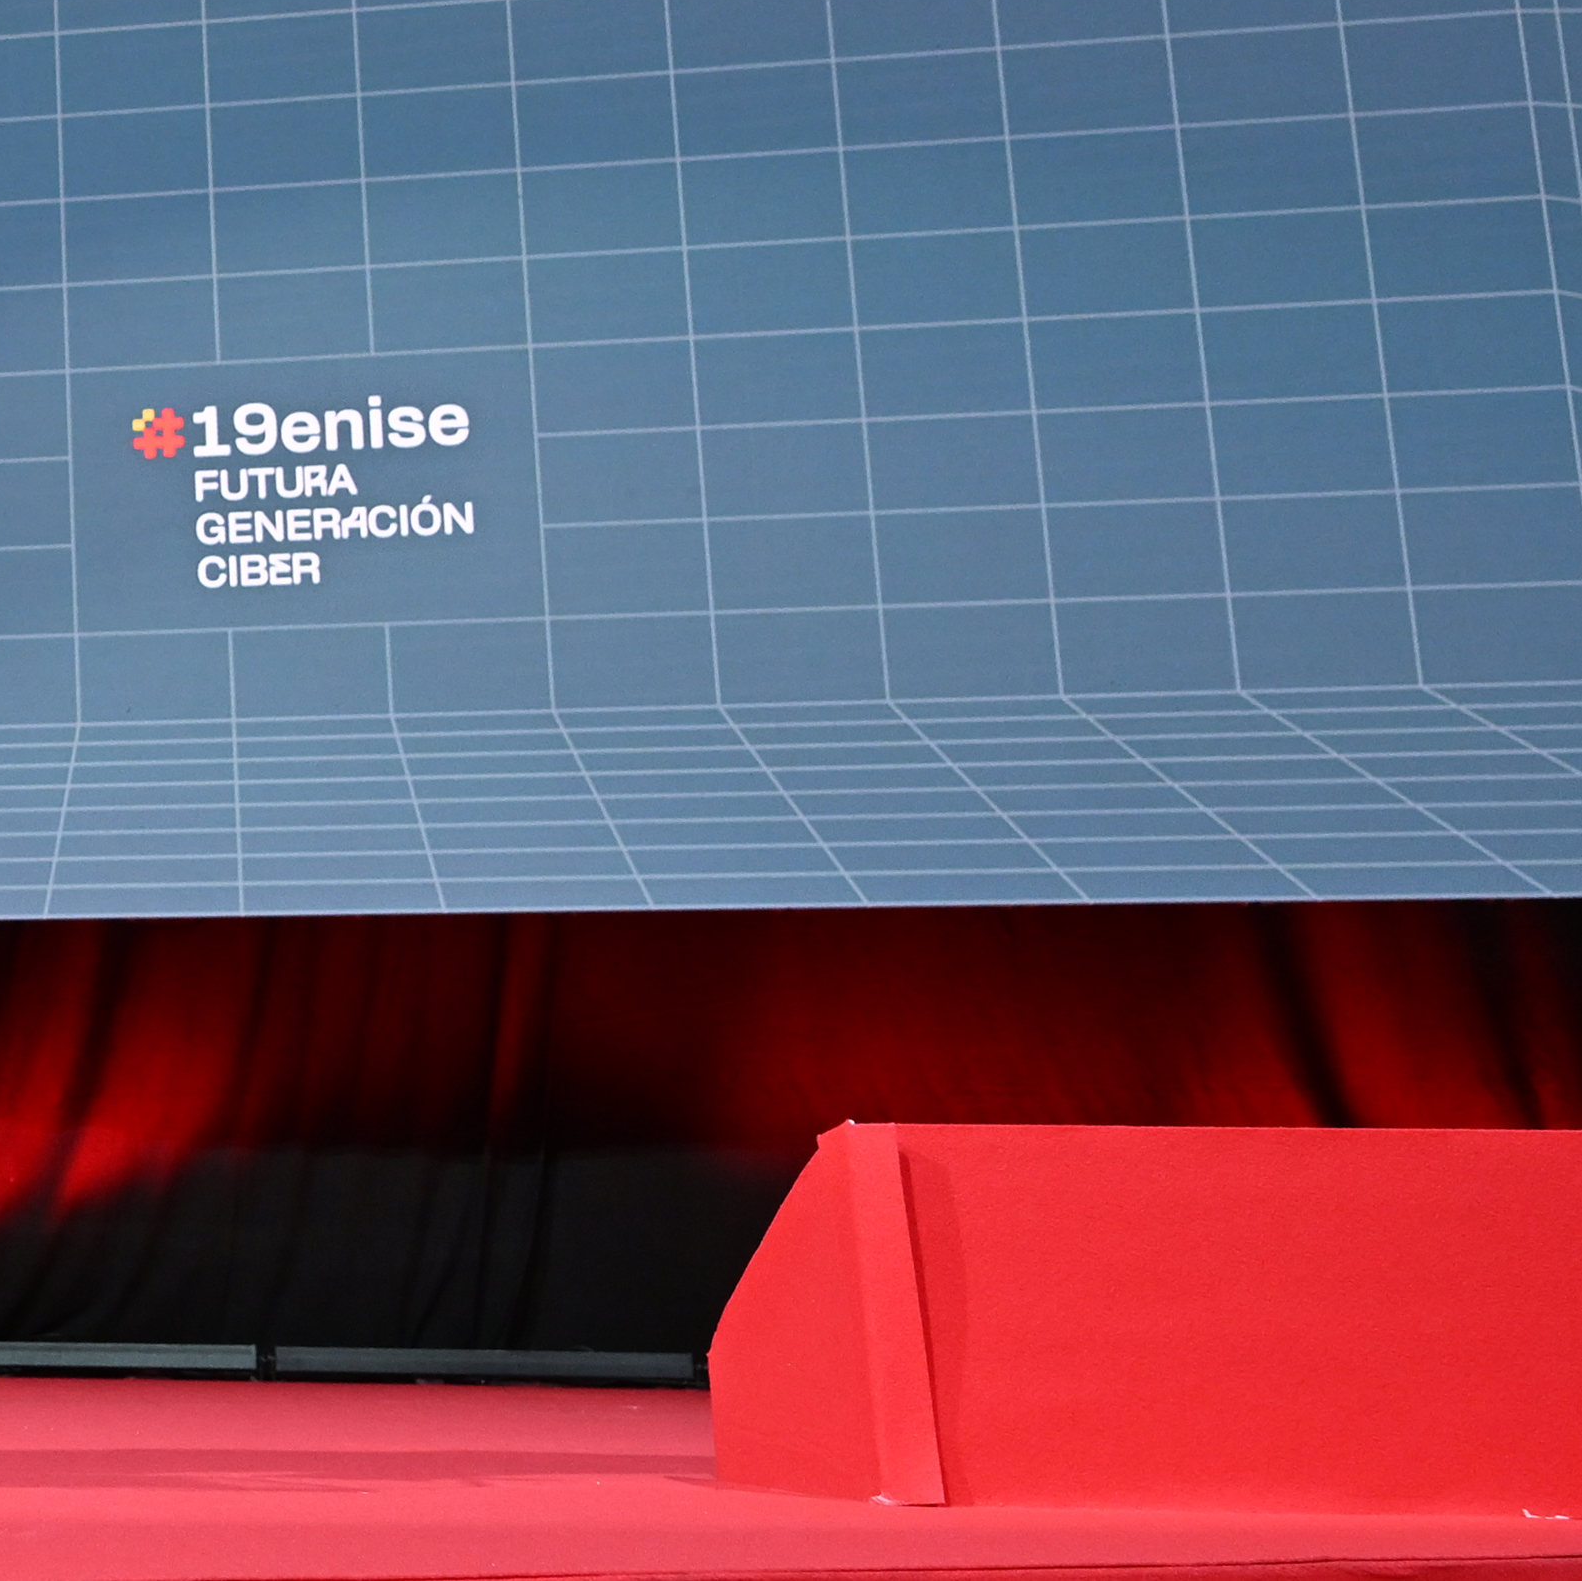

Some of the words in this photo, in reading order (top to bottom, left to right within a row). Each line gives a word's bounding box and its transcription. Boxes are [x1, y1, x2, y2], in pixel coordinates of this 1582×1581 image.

[132, 394, 470, 460] #19enise
[194, 463, 359, 503] FUTURA
[195, 494, 475, 546] GENERACIÓN
[197, 551, 321, 589] CIBER
